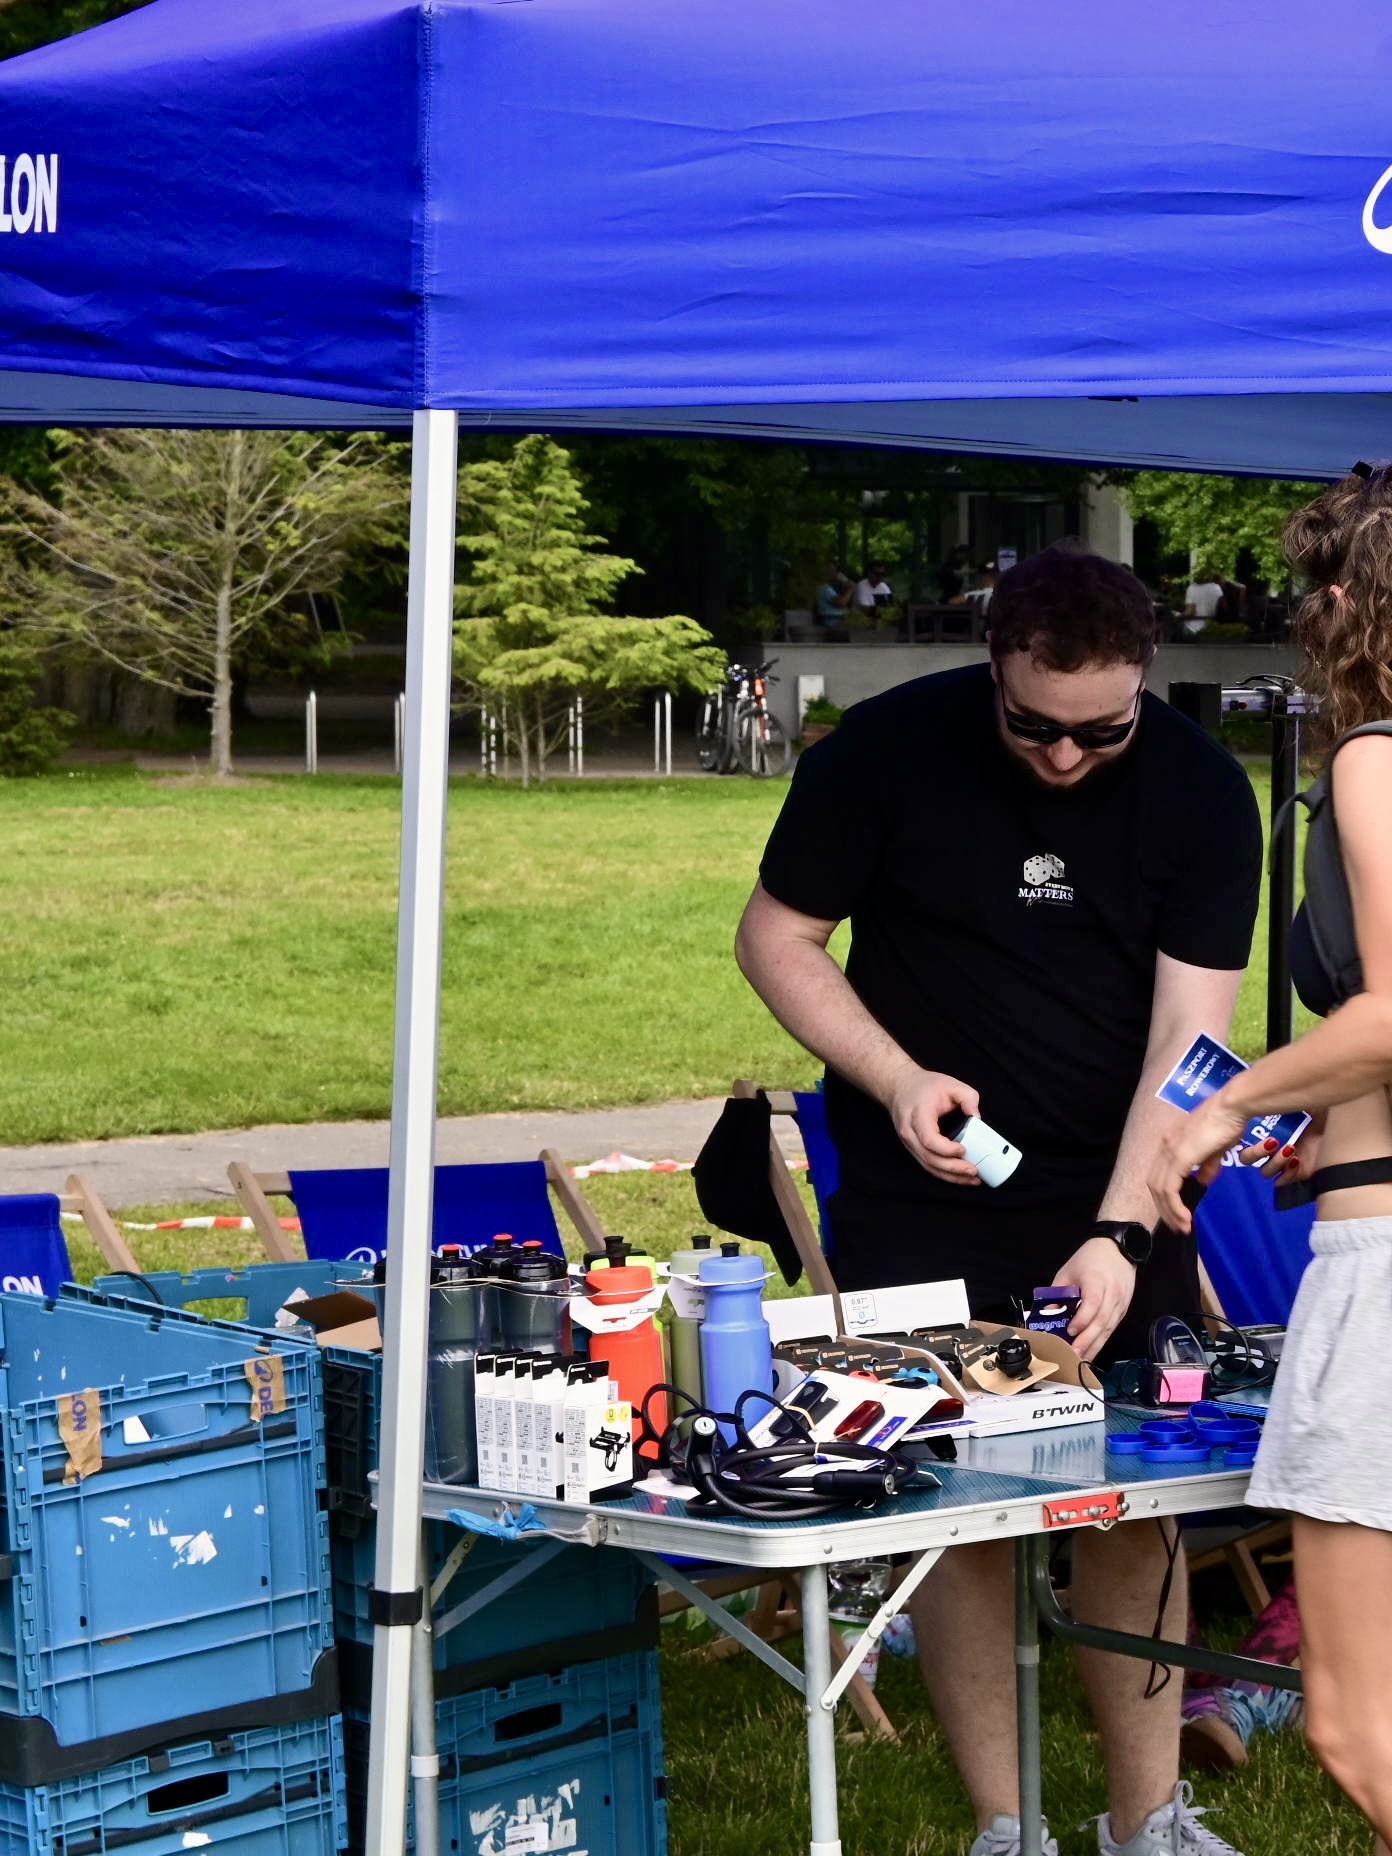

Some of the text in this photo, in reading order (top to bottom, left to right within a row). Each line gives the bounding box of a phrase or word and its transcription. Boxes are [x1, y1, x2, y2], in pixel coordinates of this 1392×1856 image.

[0, 153, 58, 233] LON
[1018, 888, 1073, 901] MATTERS
[1176, 1047, 1208, 1087] PASZPORT
[1185, 1053, 1221, 1097] ROWEROWY
